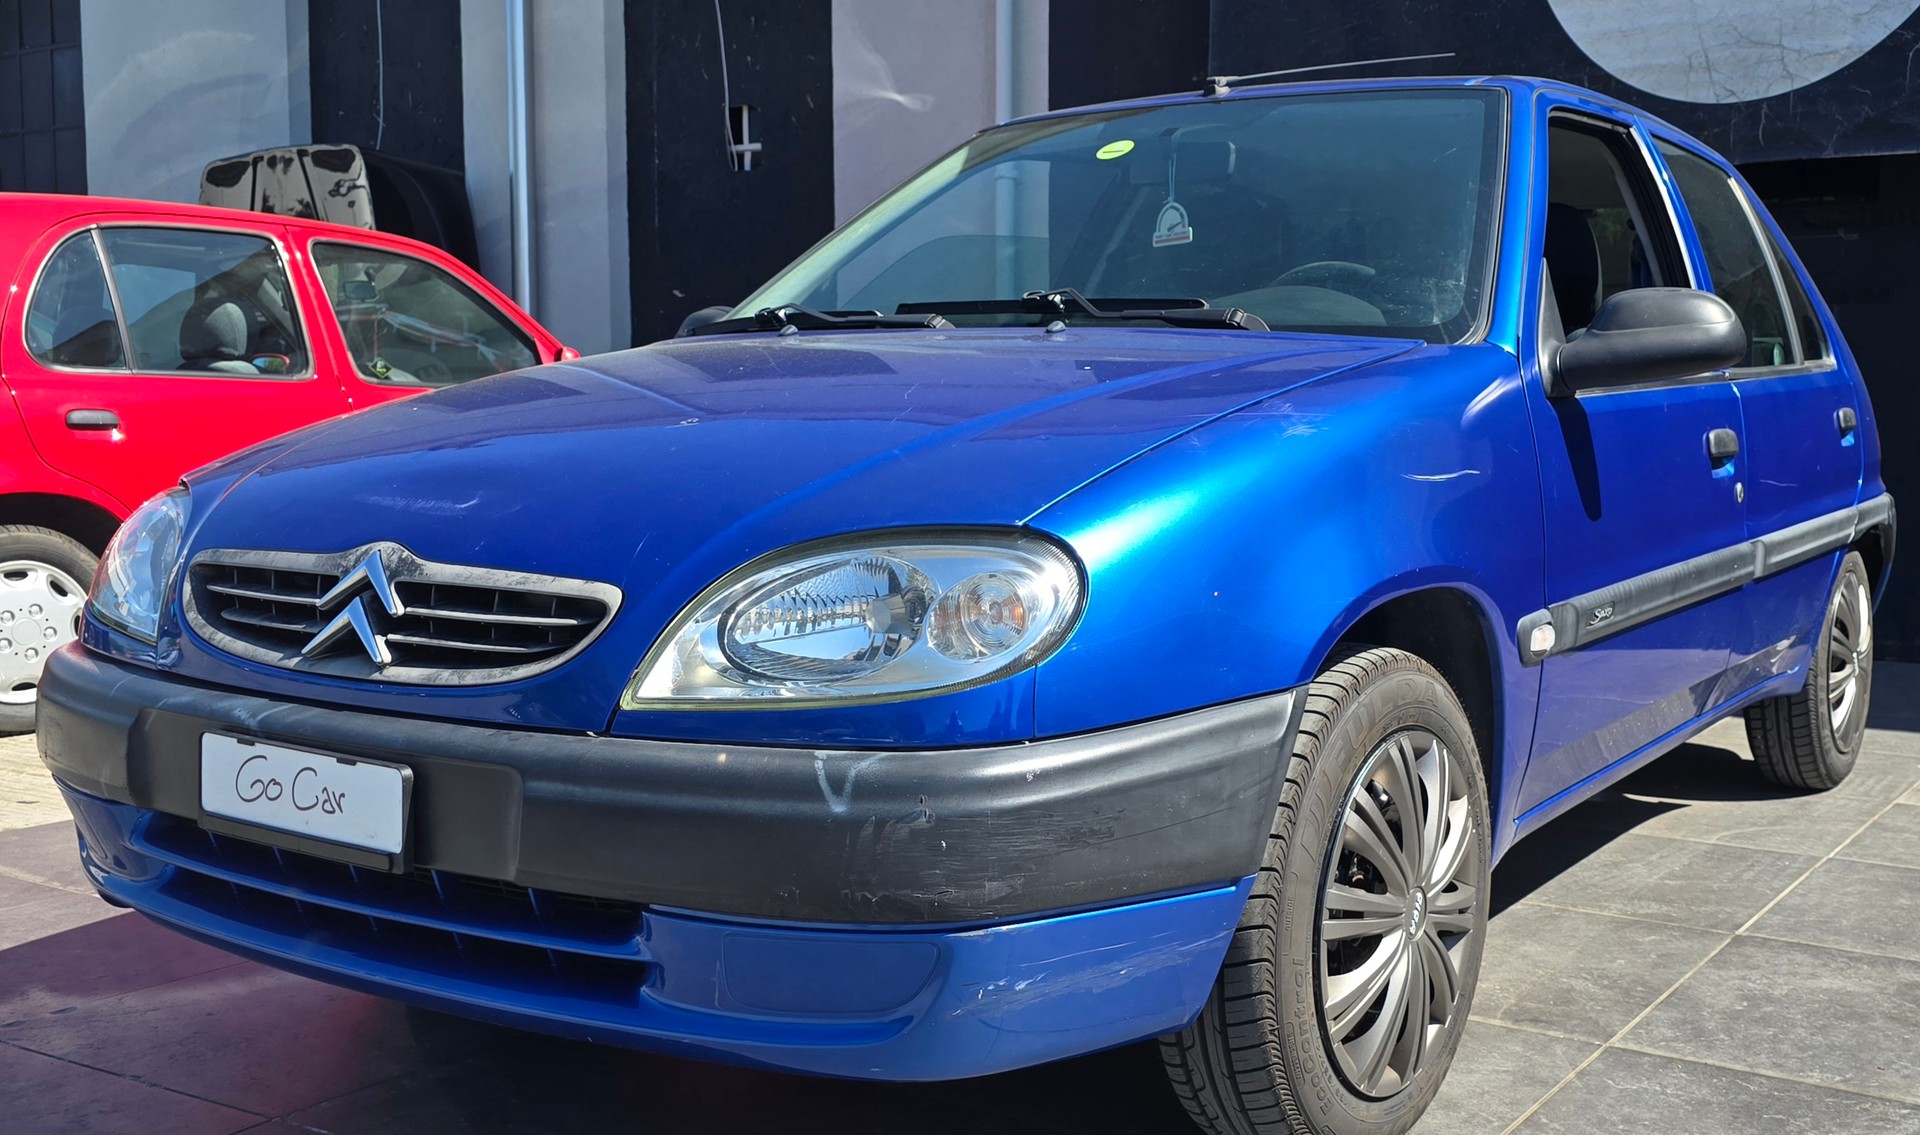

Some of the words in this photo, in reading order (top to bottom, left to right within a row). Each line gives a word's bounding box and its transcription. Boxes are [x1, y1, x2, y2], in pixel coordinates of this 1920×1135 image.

[235, 754, 283, 803] Go
[291, 766, 346, 815] Car
[1293, 956, 1334, 1116] EcoControl
